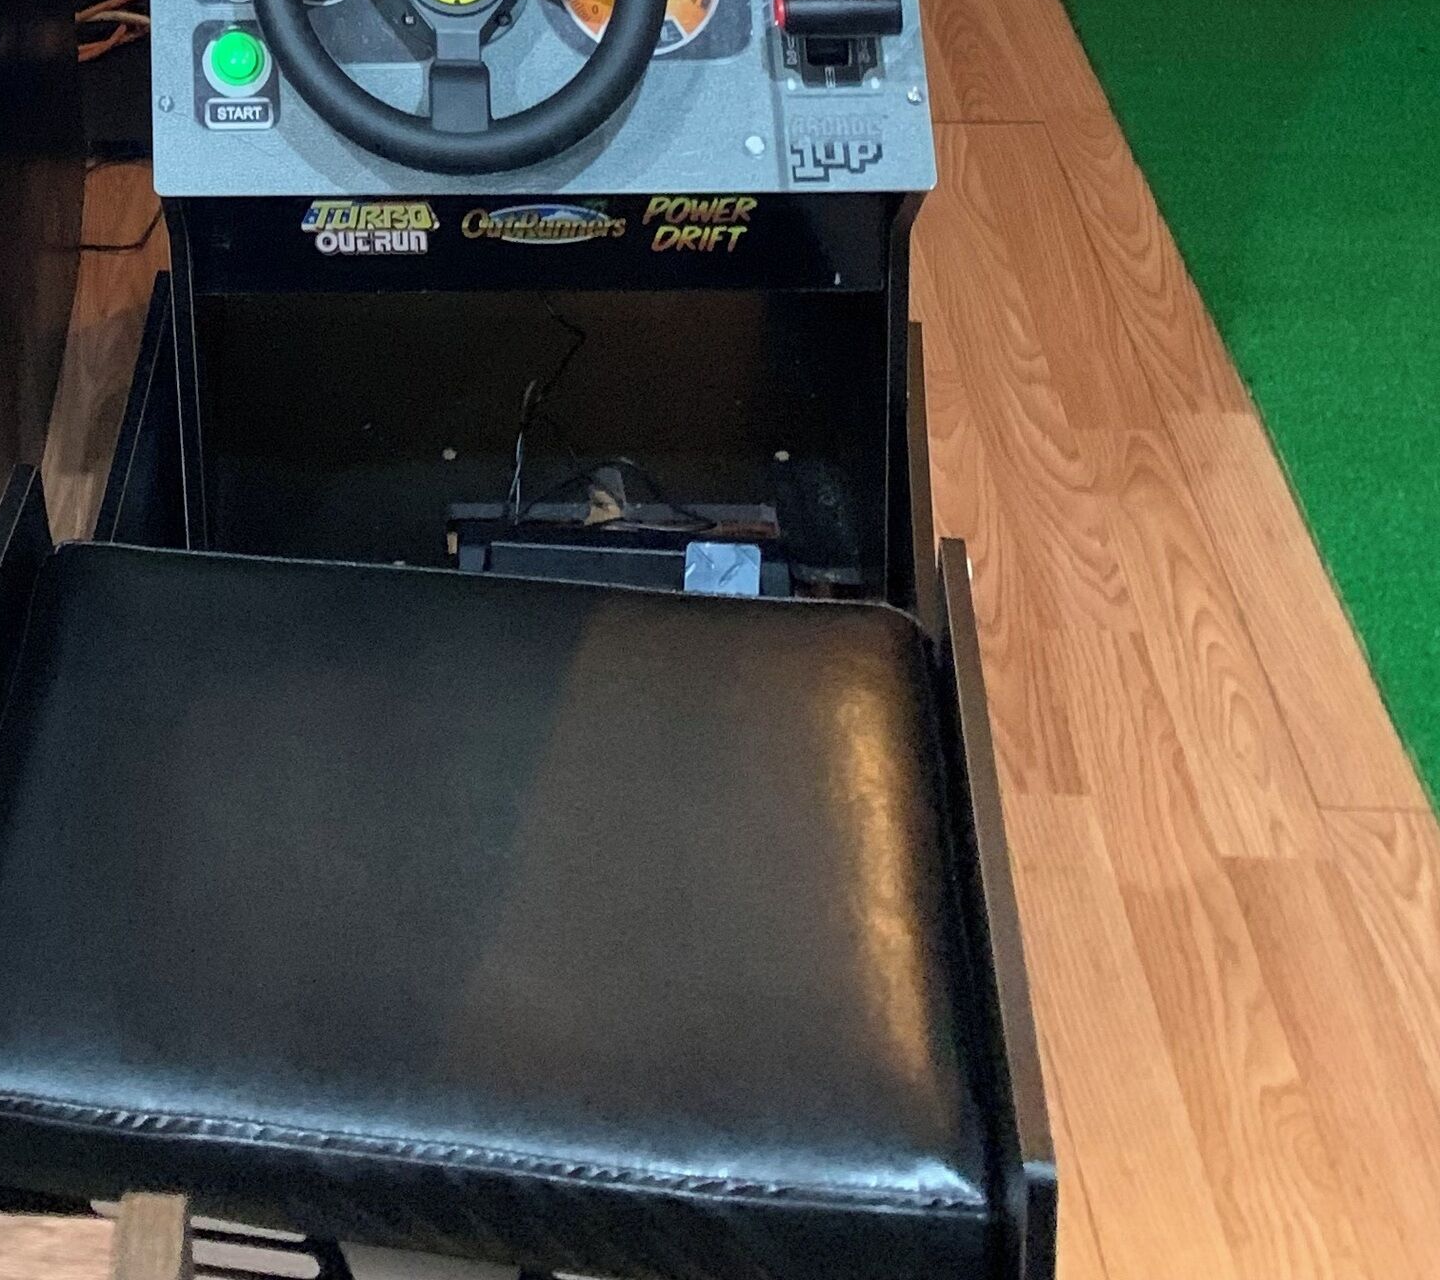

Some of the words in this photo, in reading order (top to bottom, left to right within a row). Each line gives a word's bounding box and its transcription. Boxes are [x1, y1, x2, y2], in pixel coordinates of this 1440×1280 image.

[216, 105, 263, 121] START
[310, 199, 437, 231] TURBO
[461, 207, 628, 241] OutRunners
[641, 196, 758, 225] POWER
[649, 223, 749, 253] DRIFT
